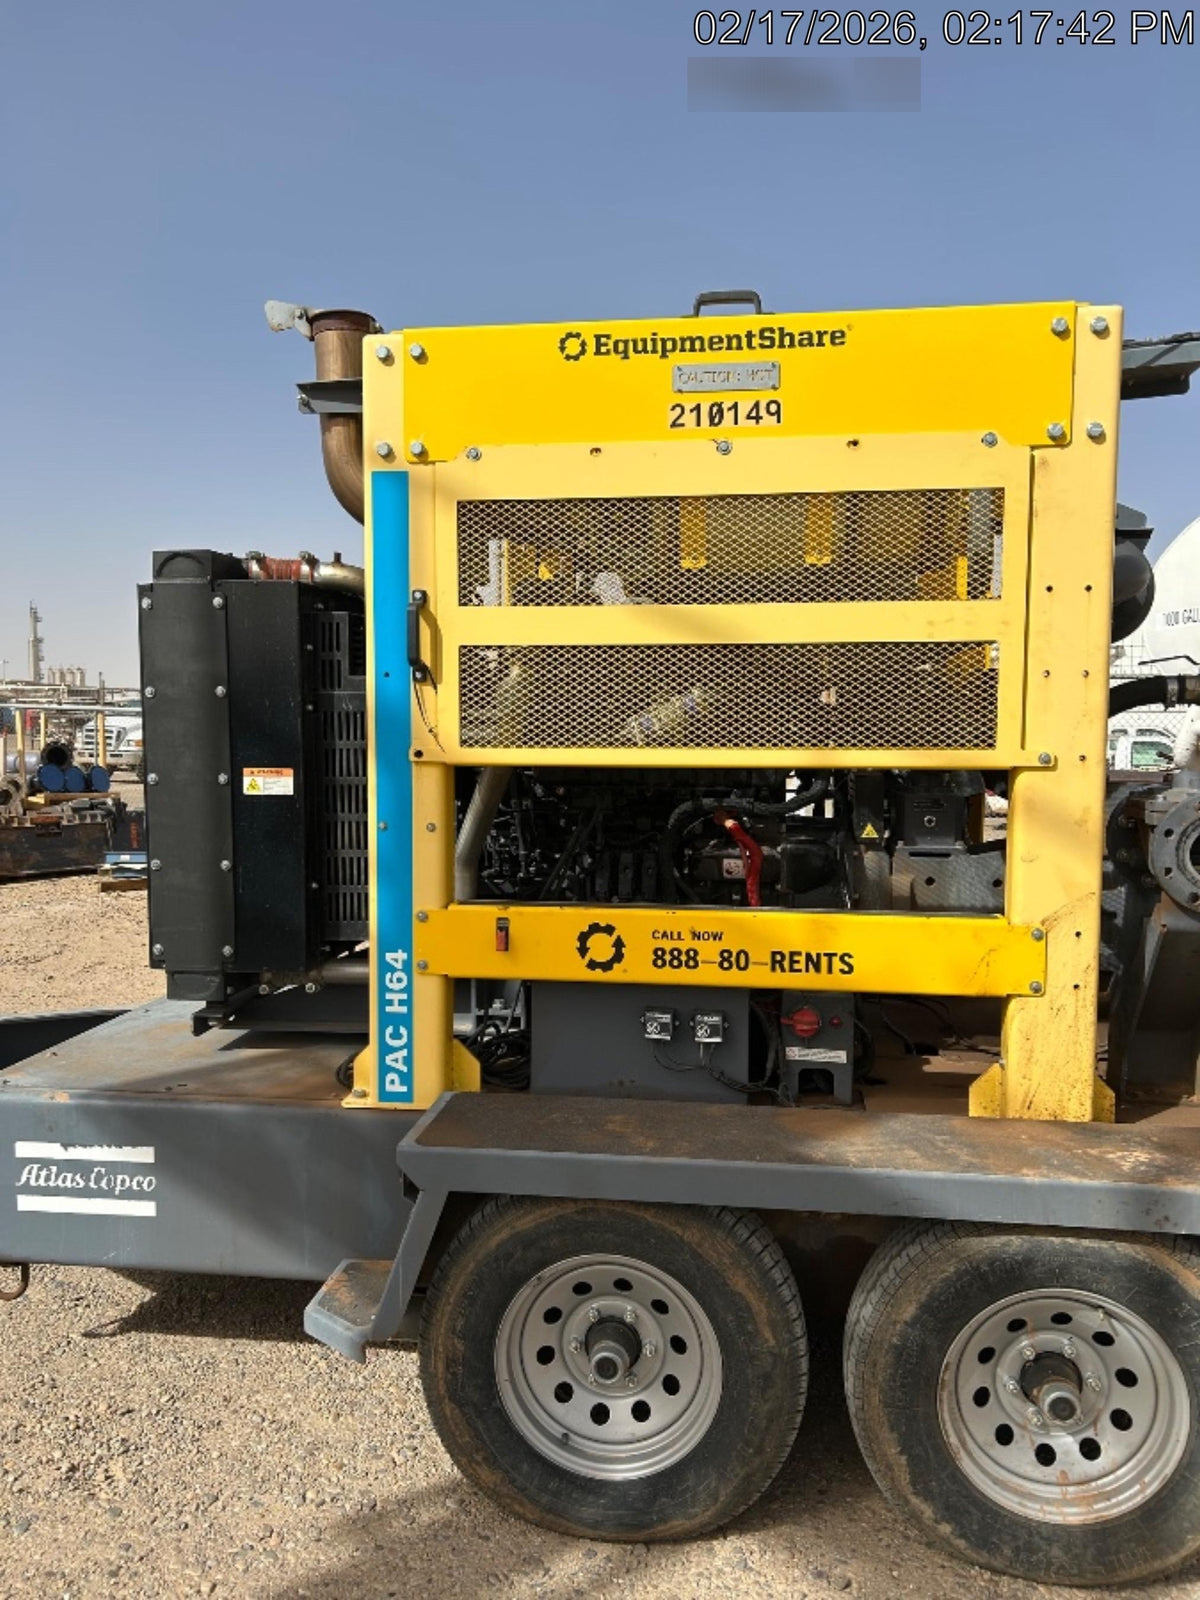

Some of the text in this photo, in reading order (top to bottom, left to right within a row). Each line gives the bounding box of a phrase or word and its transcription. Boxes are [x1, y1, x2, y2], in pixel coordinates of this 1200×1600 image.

[593, 327, 846, 360] EquipmentShare
[669, 399, 782, 429] 210149
[652, 929, 724, 942] CALL NOW
[652, 946, 854, 975] 888-80-RENTS
[385, 949, 408, 1093] PAC H64
[15, 1164, 156, 1195] Atlas Copco
